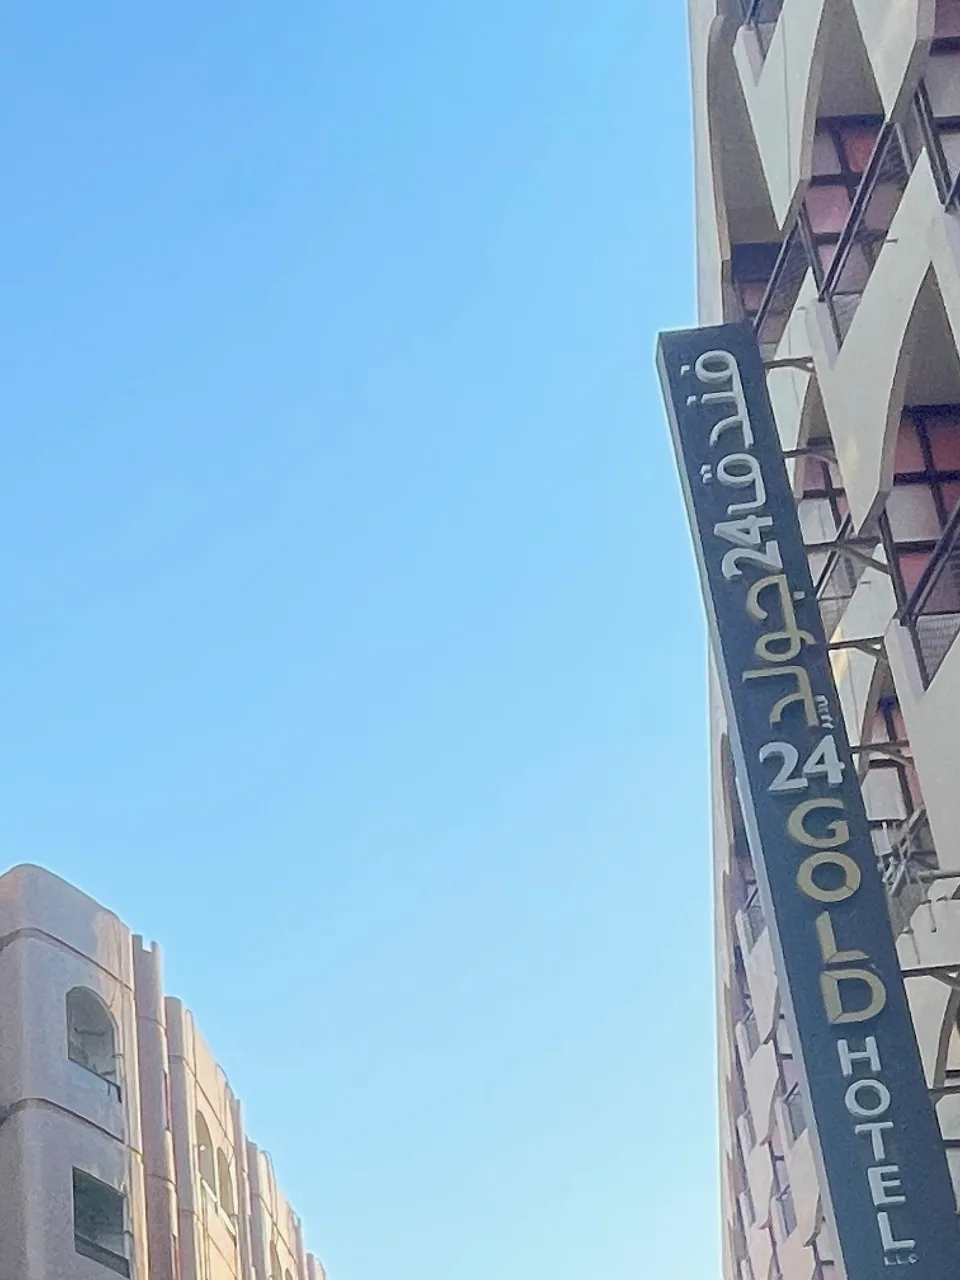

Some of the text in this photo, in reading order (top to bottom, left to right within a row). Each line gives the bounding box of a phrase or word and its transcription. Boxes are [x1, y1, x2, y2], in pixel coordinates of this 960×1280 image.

[680, 349, 819, 730] فندق 24 جولد
[759, 734, 916, 1252] 24 GOLD HOTEL
